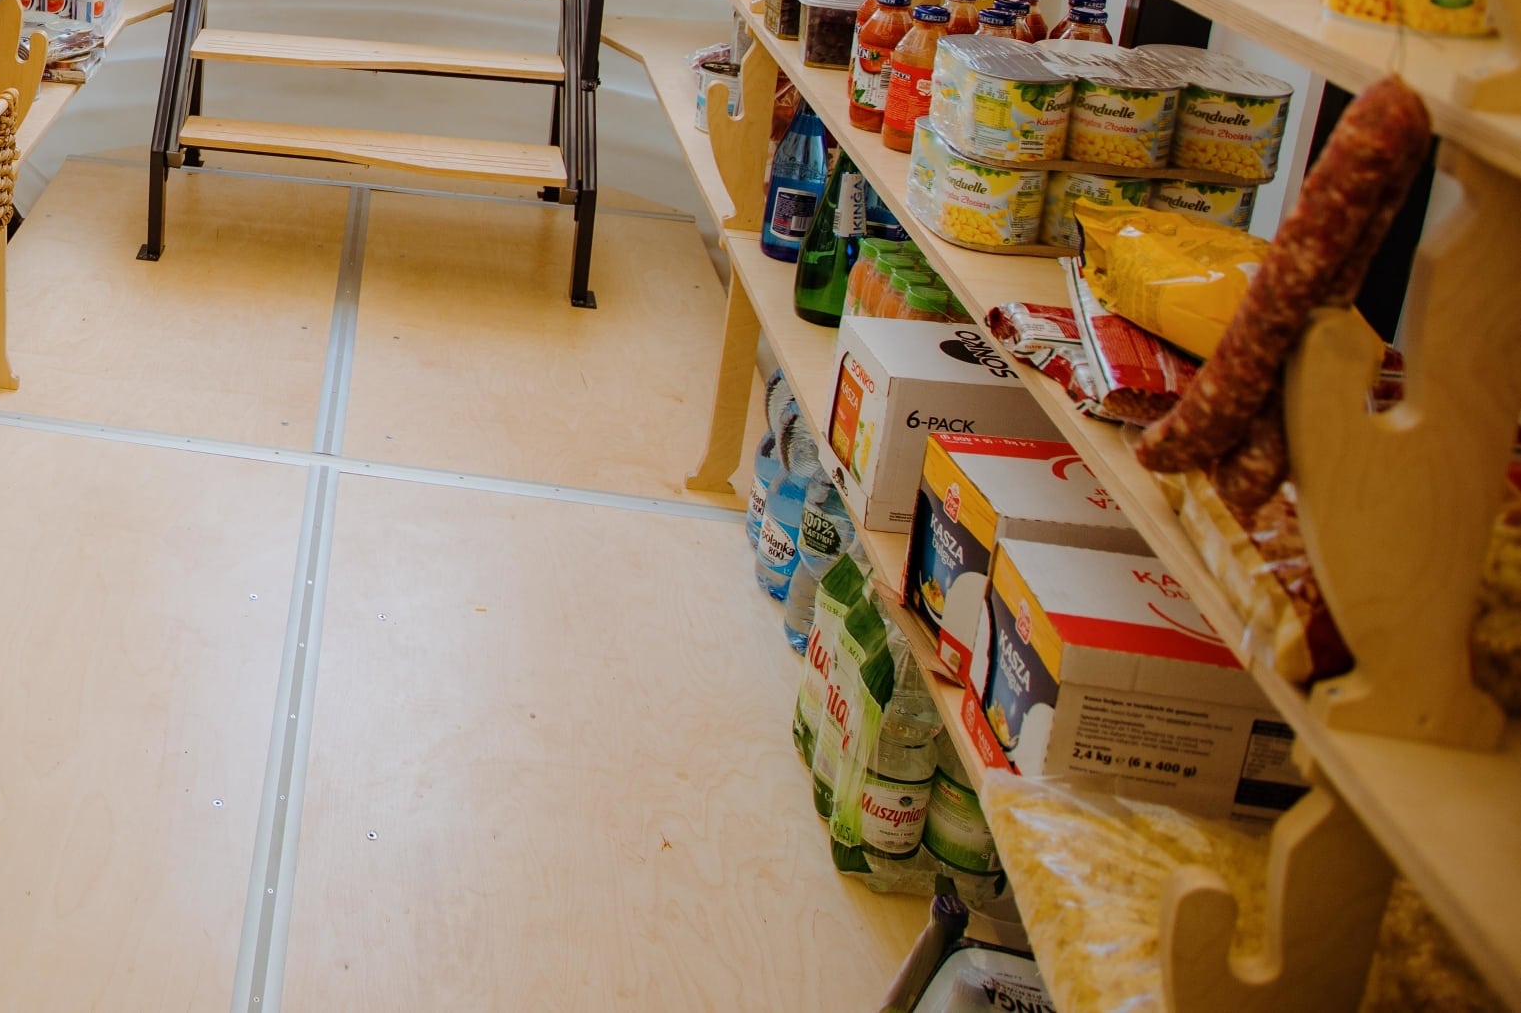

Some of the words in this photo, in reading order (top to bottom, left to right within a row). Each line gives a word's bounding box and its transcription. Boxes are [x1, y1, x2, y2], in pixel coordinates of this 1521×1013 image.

[921, 13, 948, 22] TARCZYN
[1076, 96, 1135, 119] Bonduelle
[1187, 104, 1250, 127] Bonduelle
[955, 330, 1019, 379] SONKO
[850, 359, 875, 394] SONKO
[841, 379, 859, 411] KASZA
[906, 410, 975, 433] 6-PACK
[803, 510, 836, 538] 100%
[762, 529, 795, 557] polanka
[929, 513, 964, 564] KASZA
[768, 546, 784, 561] 800
[999, 629, 1031, 692] KASZA
[1072, 747, 1092, 761] 2,4
[1096, 750, 1112, 765] kg
[1128, 756, 1141, 769] (6
[1144, 760, 1153, 769] x
[1156, 759, 1180, 773] 400
[1183, 765, 1198, 778] g)
